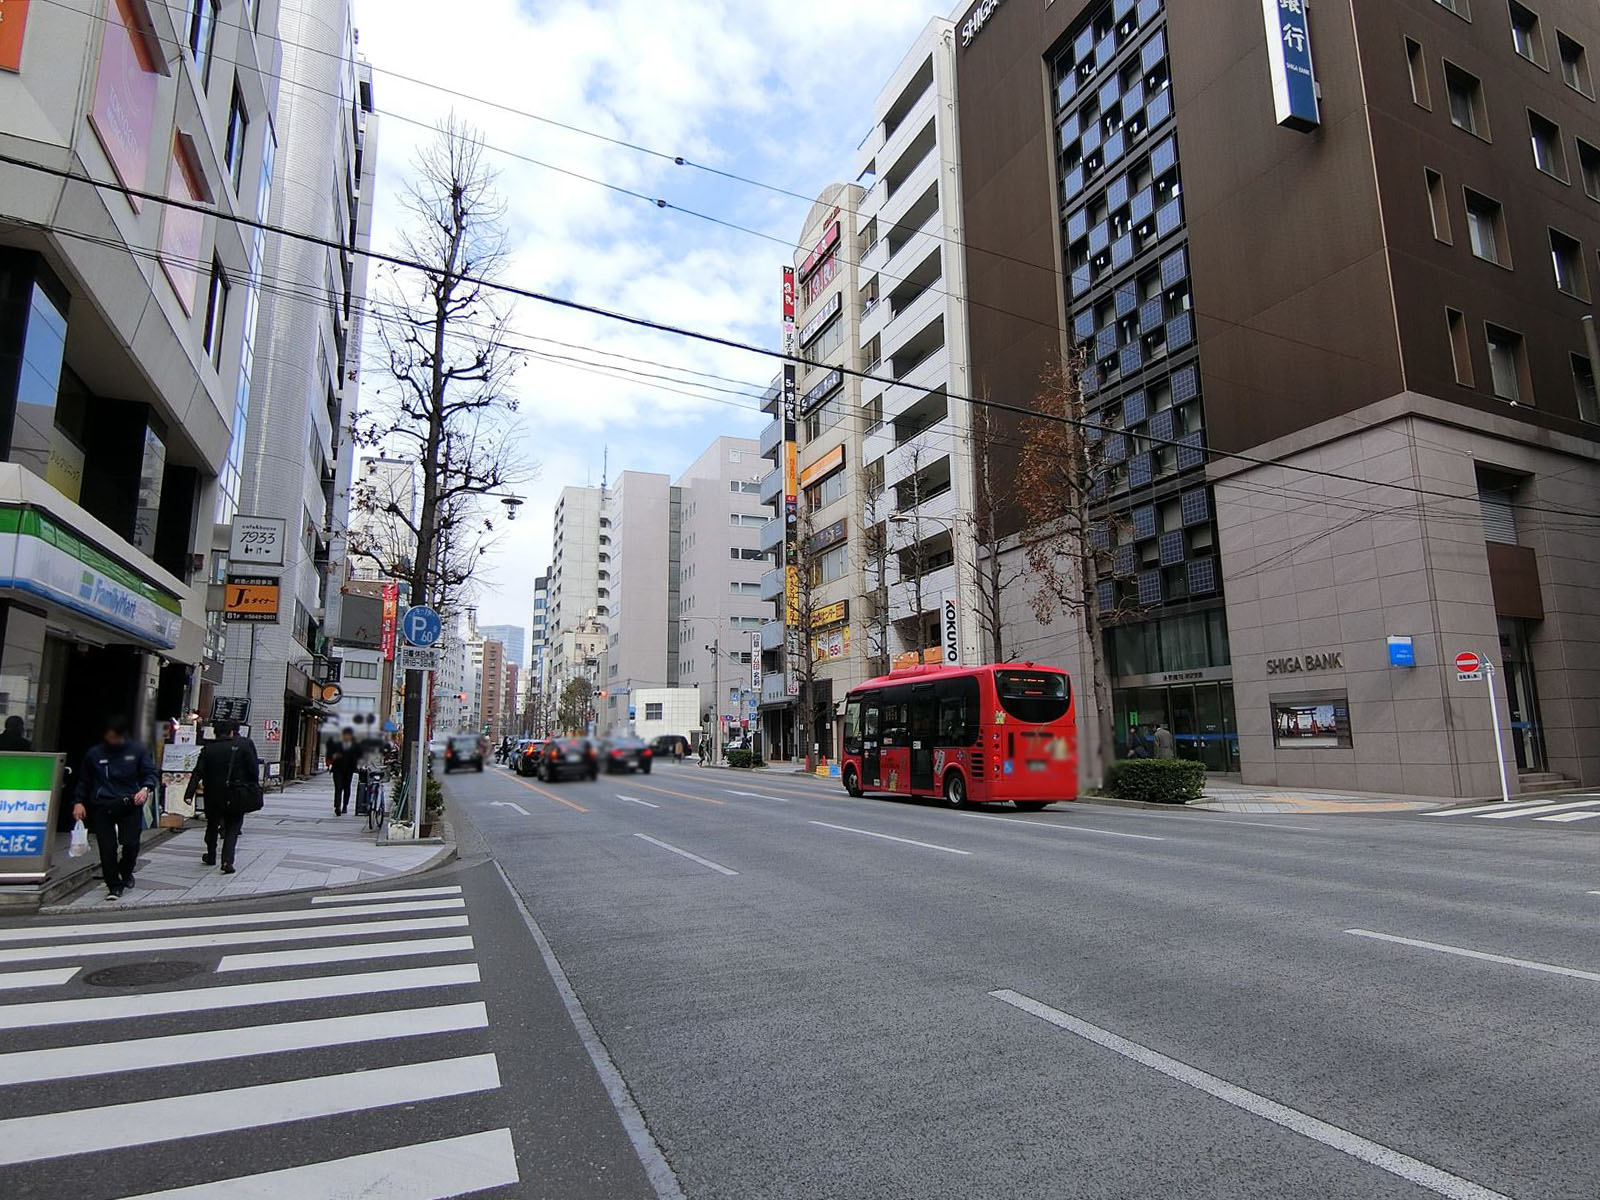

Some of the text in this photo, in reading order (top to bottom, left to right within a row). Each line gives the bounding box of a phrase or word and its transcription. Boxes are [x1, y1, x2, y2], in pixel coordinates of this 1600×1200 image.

[240, 531, 276, 544] 1933
[411, 616, 427, 641] P
[421, 631, 433, 643] 60
[945, 598, 958, 662] KOKUYO
[1266, 650, 1343, 676] SHIGA BANK
